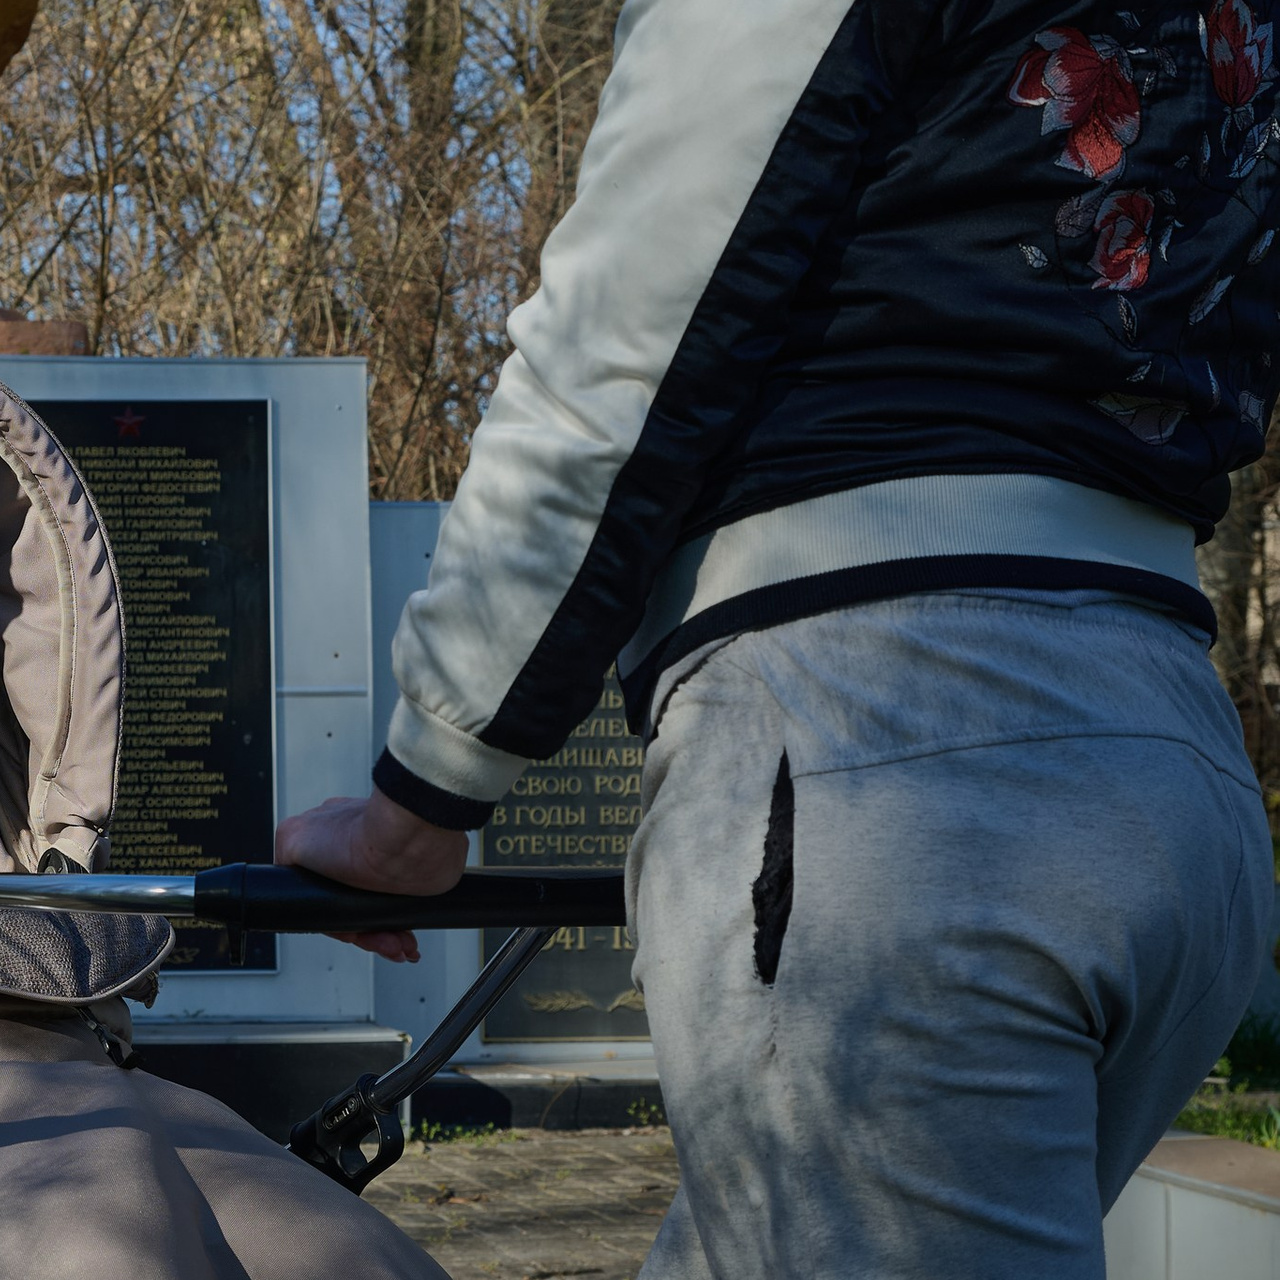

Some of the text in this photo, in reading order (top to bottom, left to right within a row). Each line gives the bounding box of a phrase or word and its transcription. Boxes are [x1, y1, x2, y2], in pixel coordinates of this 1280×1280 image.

[75, 446, 115, 457] ПАВЕЛ
[117, 446, 187, 457] ЯКОВЛЕВИЧ
[81, 458, 136, 469] НИКОЛАЙ
[138, 458, 219, 469] МИХАЙЛОВИЧ
[88, 470, 148, 481] ГРИГОРИЙ
[141, 482, 221, 493] ФЕДОСЕЕВИЧ
[98, 494, 186, 505] АИЛ ЕГОРОВИЧ
[100, 506, 123, 517] ВАН
[126, 518, 203, 529] ГАВРИЛОВИЧ
[109, 530, 219, 541] КСЕЙ ДМИТРИЕВИЧ
[113, 543, 159, 553] АНОВИЧ
[120, 566, 210, 577] НДР ИВАНОВИЧ
[121, 579, 178, 589] ТОНОВИЧ
[135, 615, 217, 626] МИХАЙЛОВИЧ
[148, 639, 219, 650] АНДРЕЕВИЧ
[146, 651, 226, 662] МИХАЙЛОВИЧ
[128, 663, 210, 674] ТИМОФЕЕВИЧ
[125, 687, 228, 698] РЕЙ СТЕПАНОВИЧ
[124, 712, 224, 722] АИЛ ФЕДОРОВИЧ
[125, 760, 204, 770] ВАСИЛЬЕВИЧ
[151, 784, 228, 794] АЛЕКСЕЕВИЧ
[511, 774, 641, 797] СВОЮ РОД
[145, 796, 211, 807] ОСИПОВИЧ
[140, 808, 219, 819] СТЕПАНОВИЧ
[492, 805, 643, 829] В ГОДЫ ВЕЛ
[125, 845, 203, 855] АЛЕКСЕЕВИЧ
[496, 835, 633, 855] ОТЕЧЕСТВ
